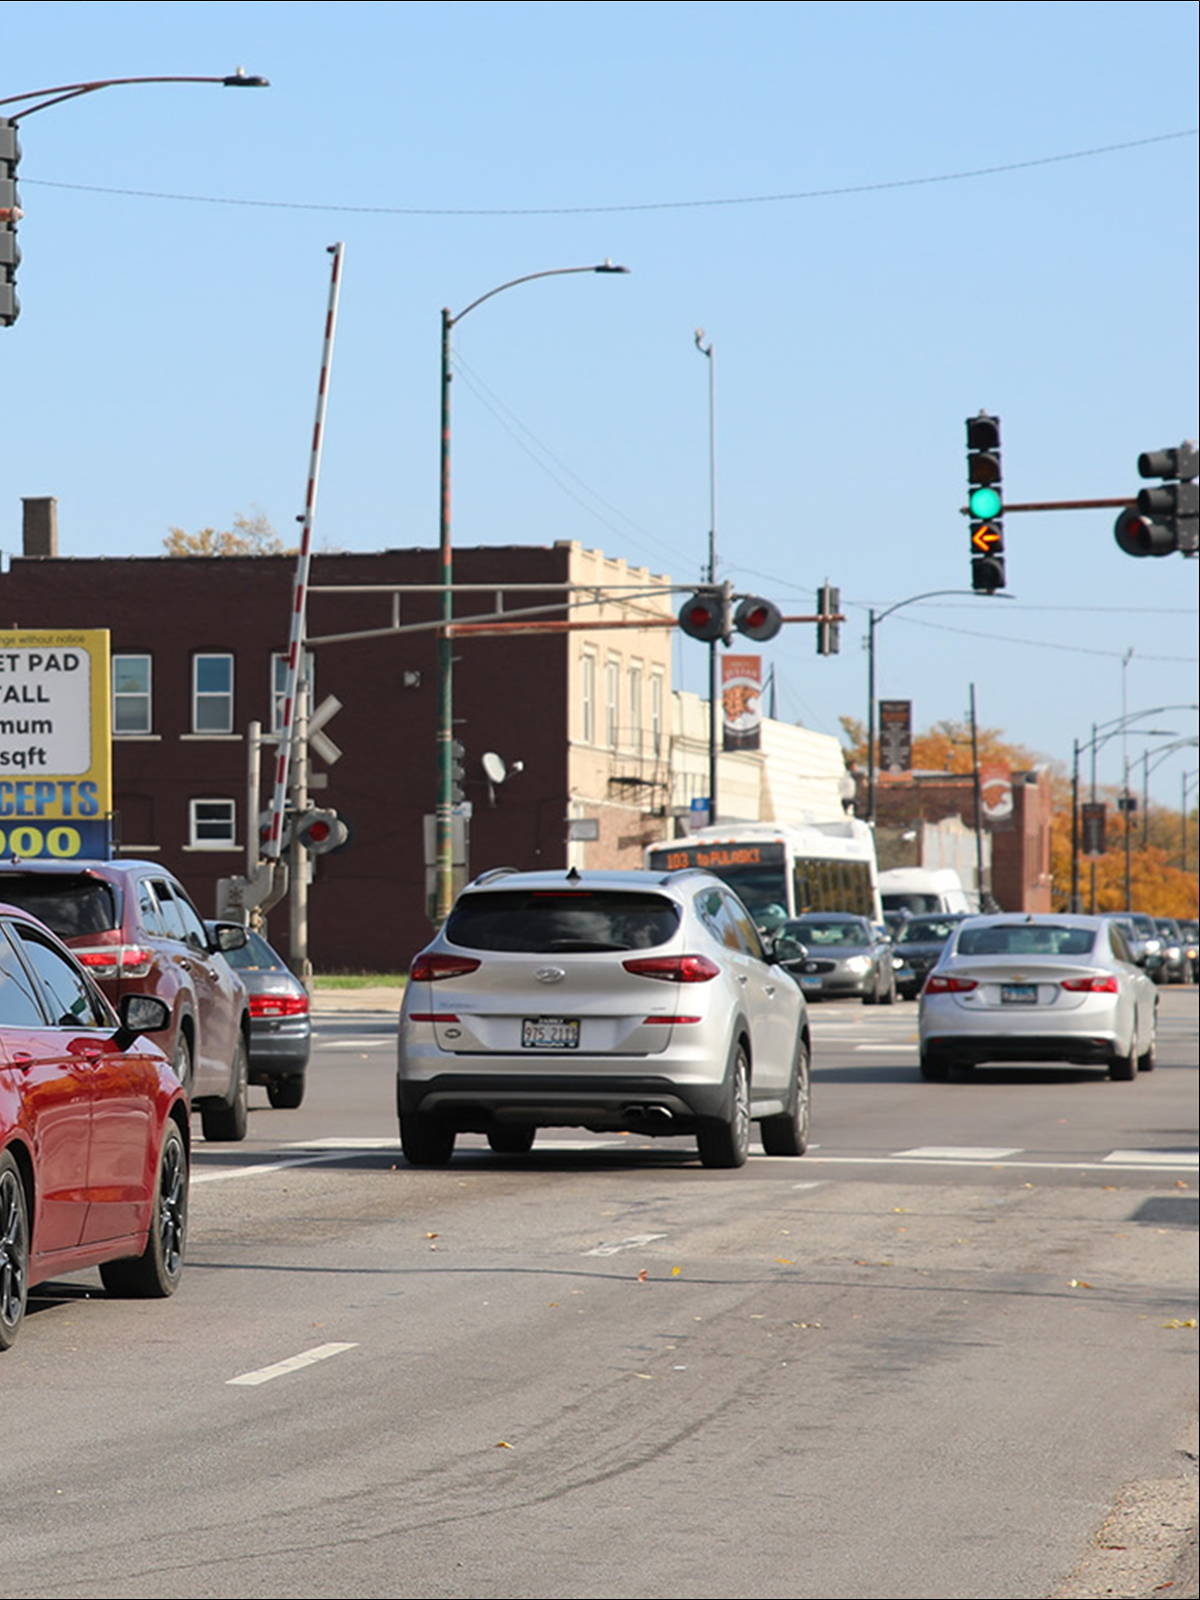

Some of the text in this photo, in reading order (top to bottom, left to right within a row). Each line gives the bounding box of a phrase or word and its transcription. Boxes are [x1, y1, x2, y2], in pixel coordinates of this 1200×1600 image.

[19, 635, 53, 645] without
[56, 634, 86, 644] notice
[28, 653, 80, 672] PAD
[667, 852, 689, 870] 103
